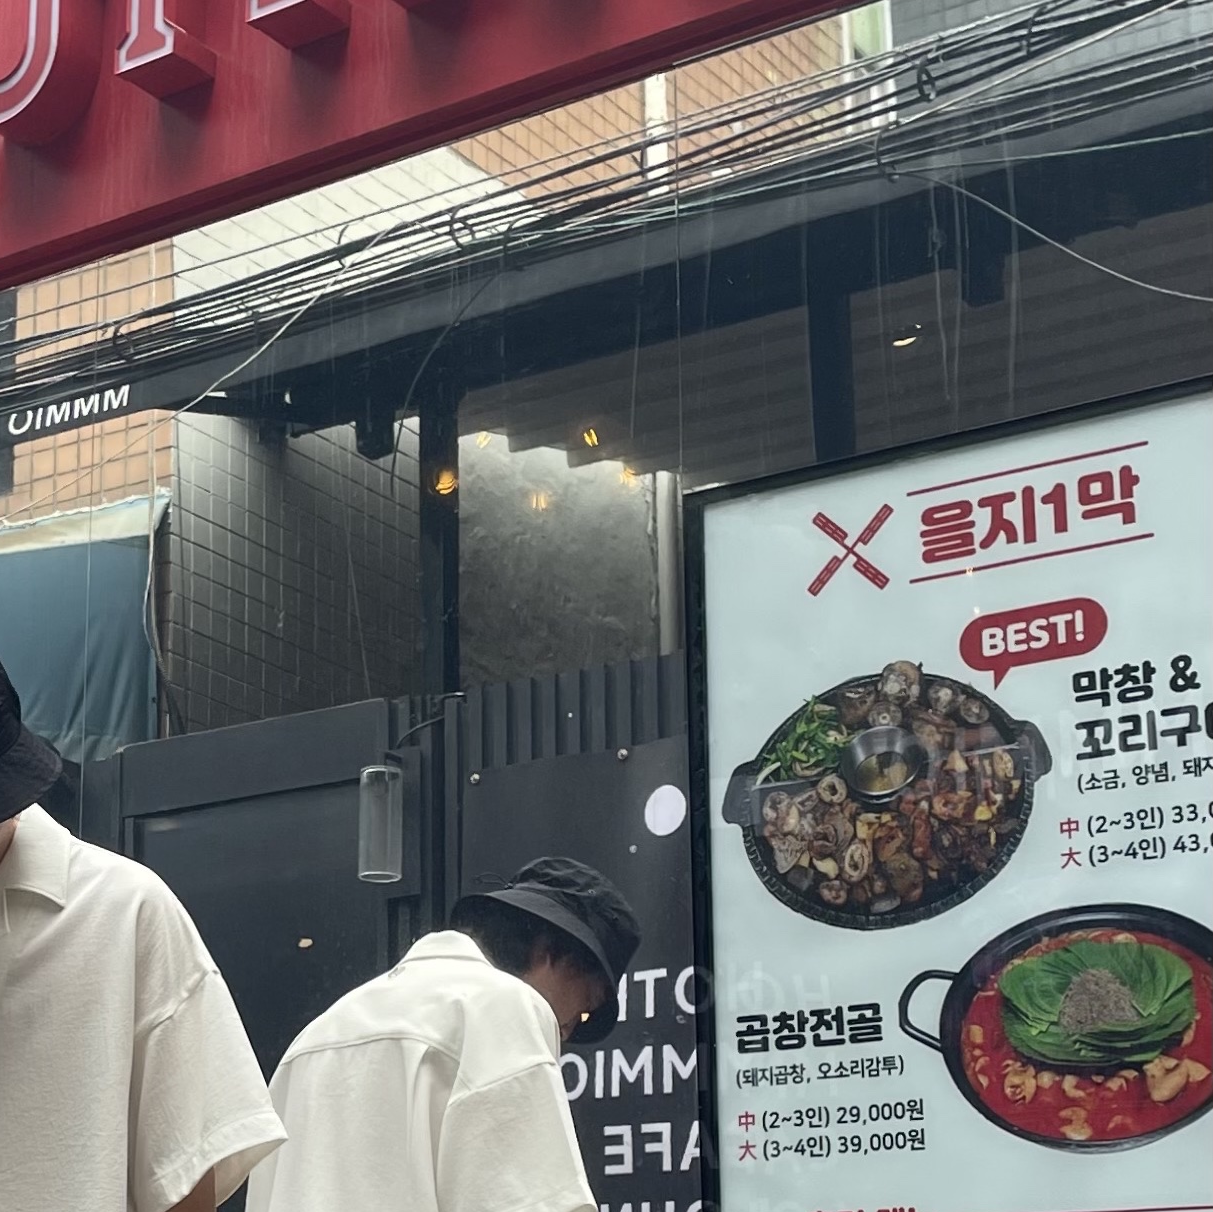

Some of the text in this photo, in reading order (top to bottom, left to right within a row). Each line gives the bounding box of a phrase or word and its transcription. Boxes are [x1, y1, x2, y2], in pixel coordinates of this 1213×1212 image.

[919, 465, 1141, 565] 을지1막
[980, 608, 1085, 658] BEST!
[1072, 654, 1202, 708] 막창 &
[1077, 768, 1126, 795] (소금,
[1131, 760, 1176, 786] 양념,
[1059, 817, 1080, 840] 中
[1087, 806, 1164, 838] (2~3인)
[1060, 846, 1082, 870] 大
[1088, 836, 1167, 868] (3~4인)
[735, 1002, 884, 1054] 곱창전골
[735, 1054, 905, 1090] (돼지곱창, 오소리감투)
[738, 1098, 925, 1133] 中 (2~3인) 29,000원
[738, 1127, 926, 1162] 大 (3~4인) 39,000원
